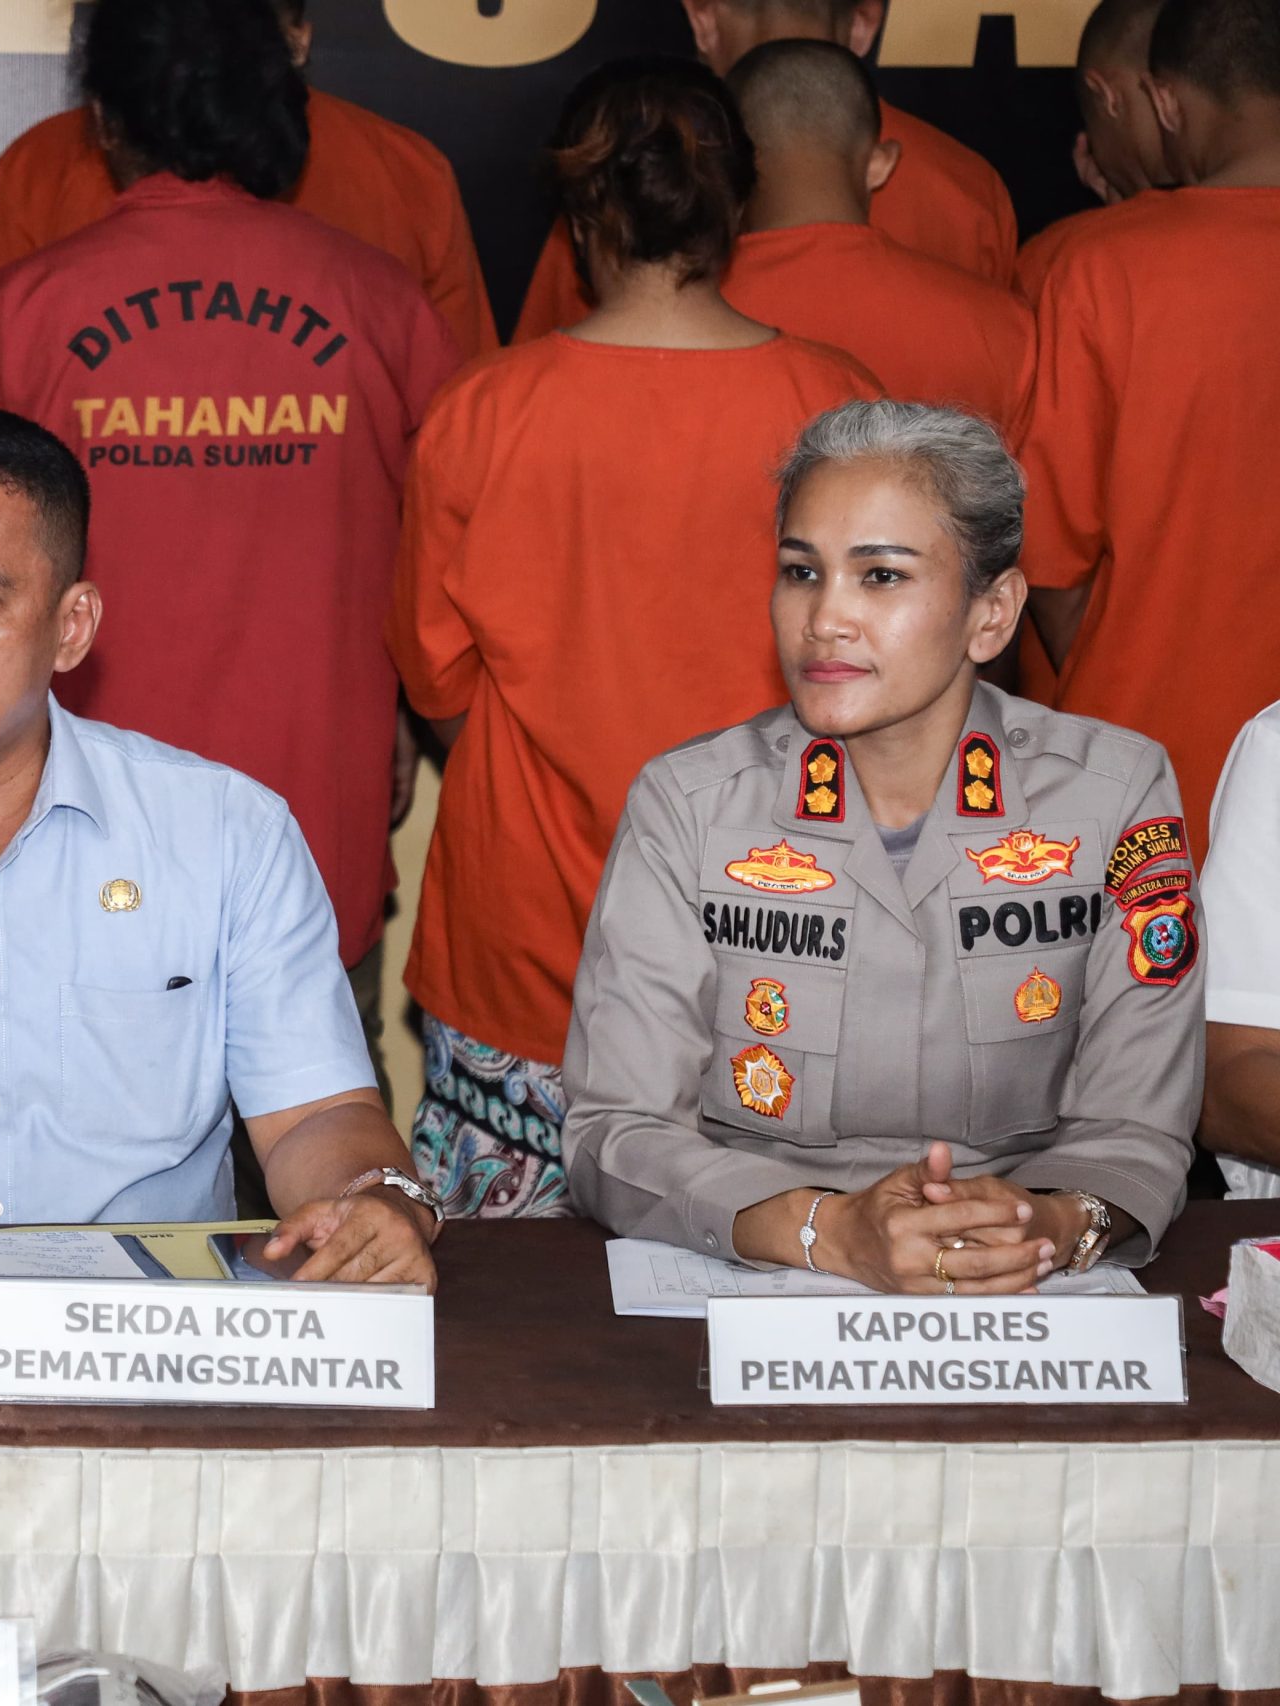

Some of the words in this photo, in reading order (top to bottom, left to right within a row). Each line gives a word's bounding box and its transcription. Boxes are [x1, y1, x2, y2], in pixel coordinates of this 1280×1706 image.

[67, 279, 349, 371] DITTAHTI
[73, 394, 348, 439] TAHANAN
[88, 444, 194, 468] POLDA
[204, 443, 318, 467] SUMUT
[1107, 823, 1171, 874] POLRES
[1146, 837, 1182, 855] SIANTAR
[1121, 878, 1161, 904] SUMATERA
[703, 901, 847, 962] SAH.UDUR.S
[958, 892, 1102, 952] POLRI
[63, 1302, 202, 1338] SEKDA
[215, 1306, 326, 1341] KOTA
[836, 1310, 1050, 1343] KAPOLRES
[740, 1359, 1153, 1391] PEMATANGSIANTAR
